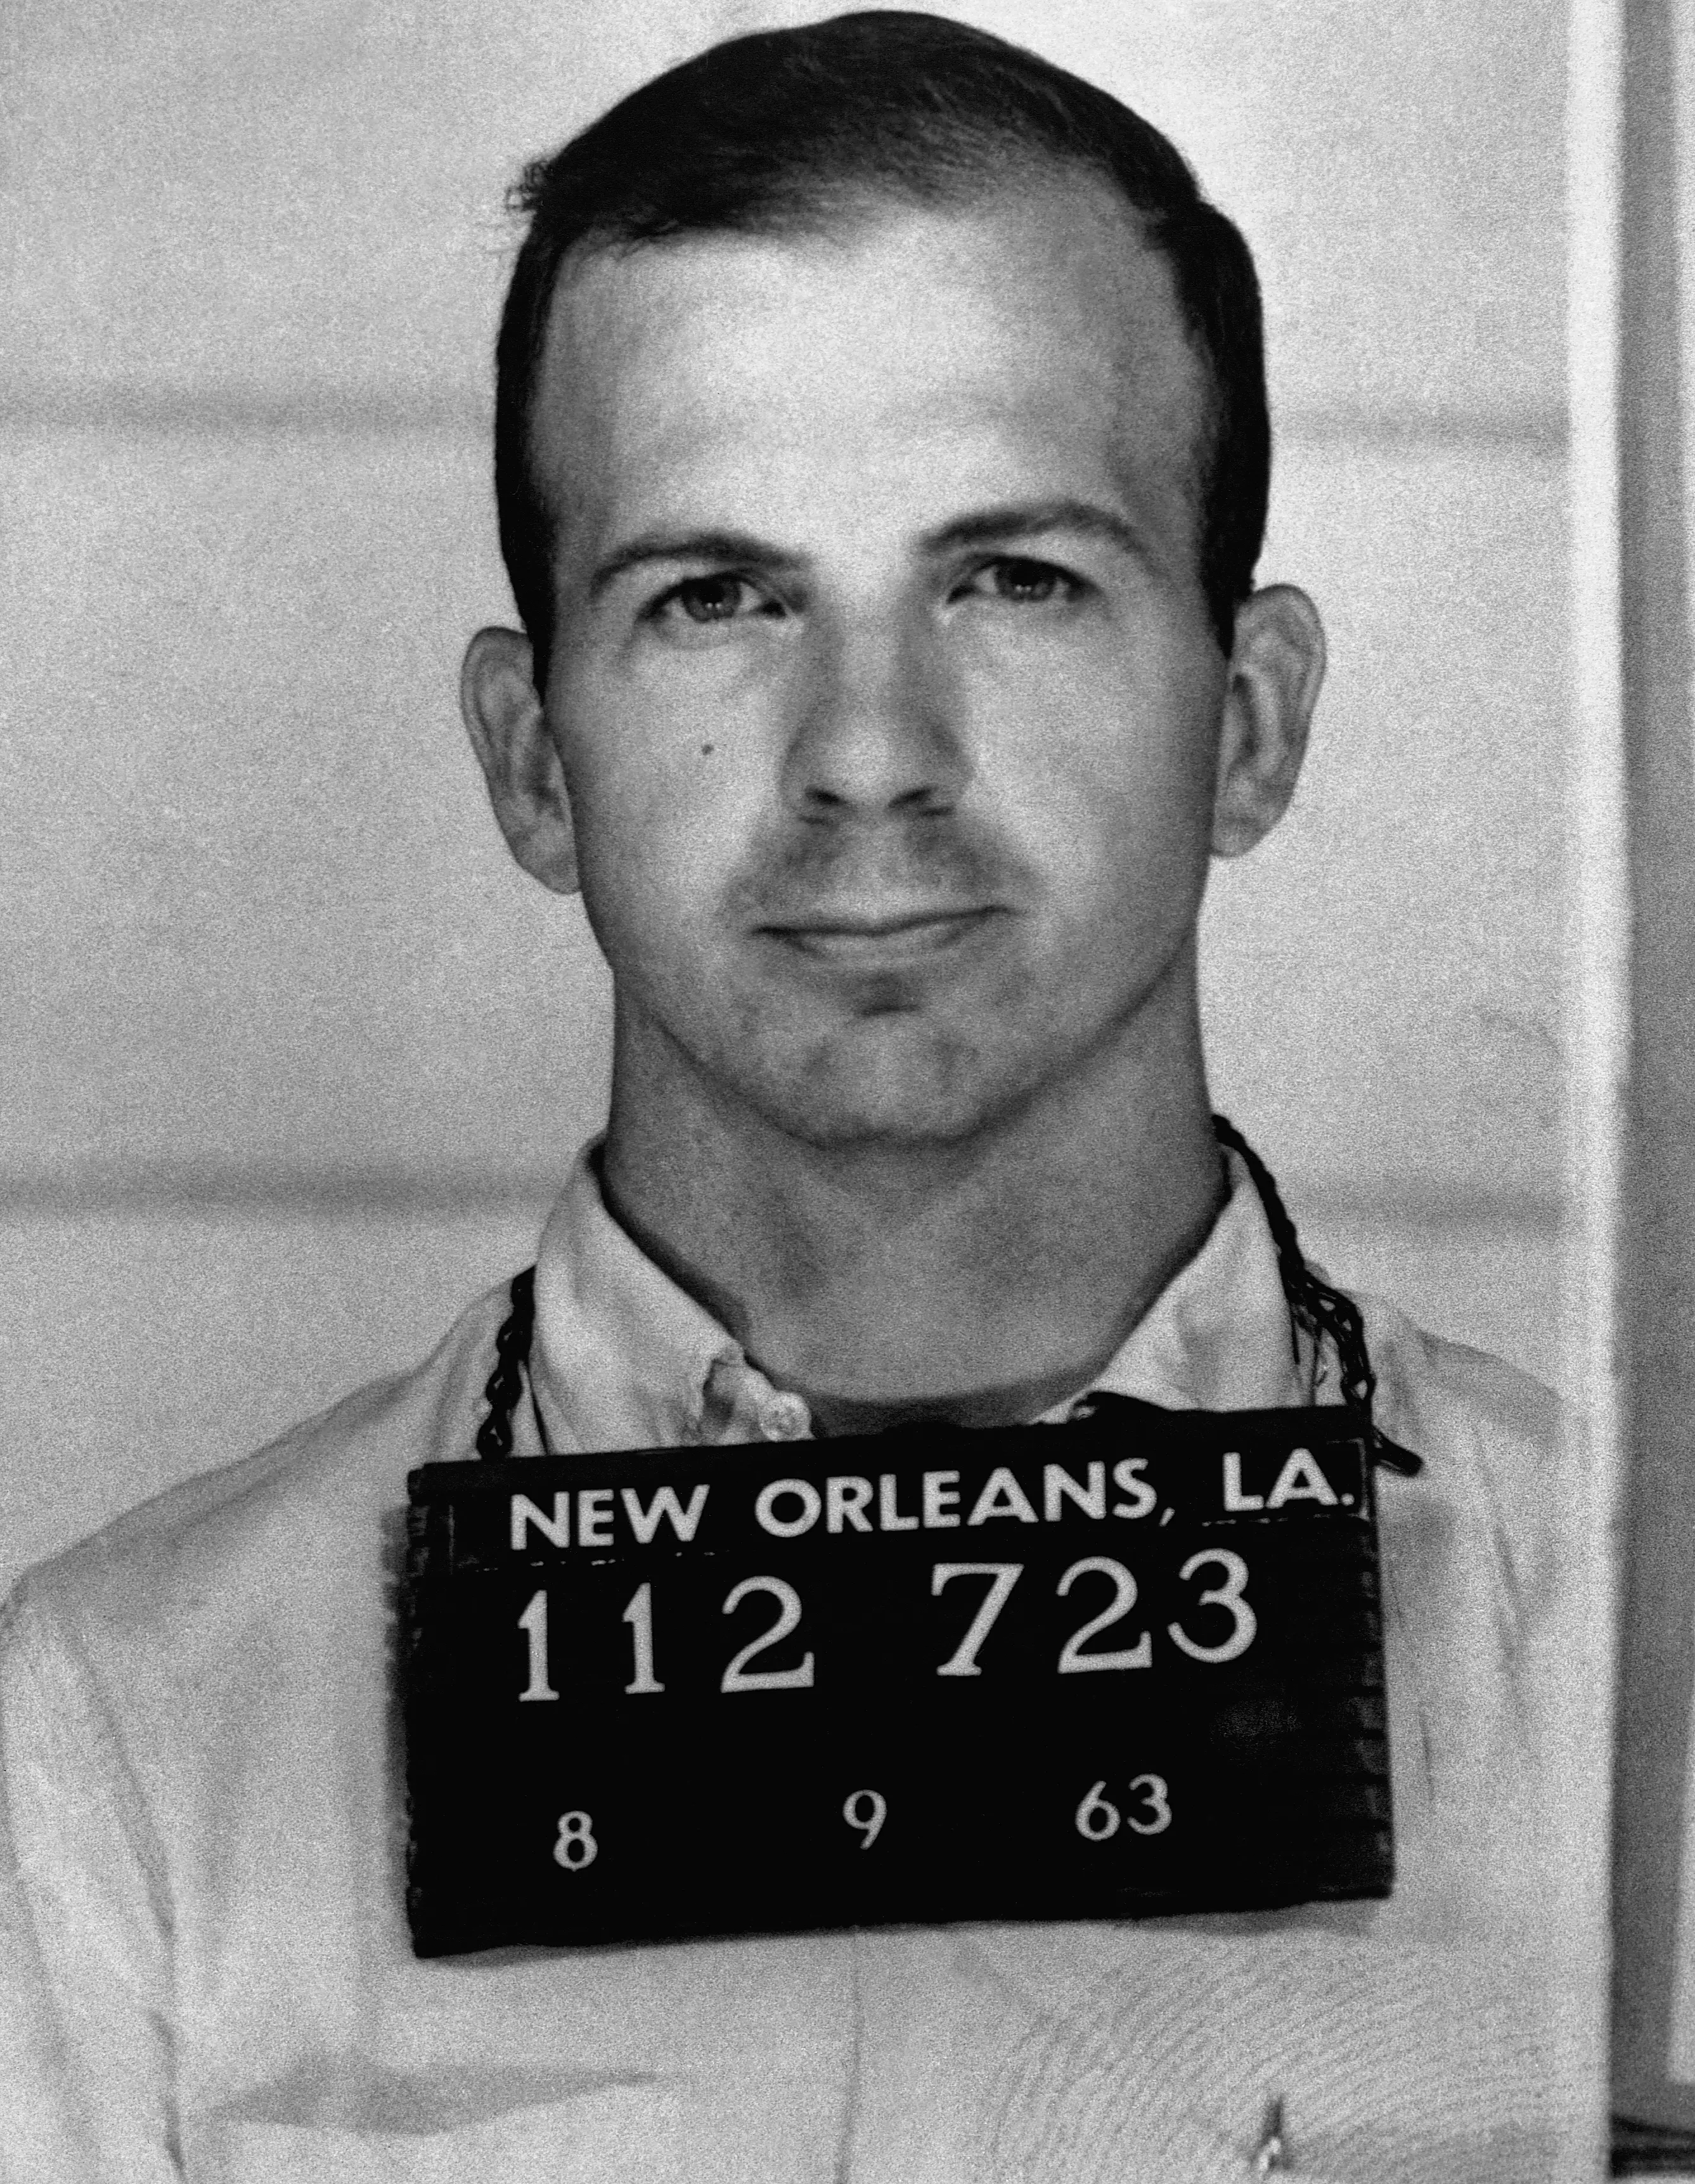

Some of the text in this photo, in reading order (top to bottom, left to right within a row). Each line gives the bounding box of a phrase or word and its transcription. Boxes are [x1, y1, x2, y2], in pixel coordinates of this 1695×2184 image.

[511, 1449, 1354, 1549] NEW ORLEANS, LA.
[932, 1549, 1256, 1676] 723
[555, 1775, 1171, 1871] 8 9 63
